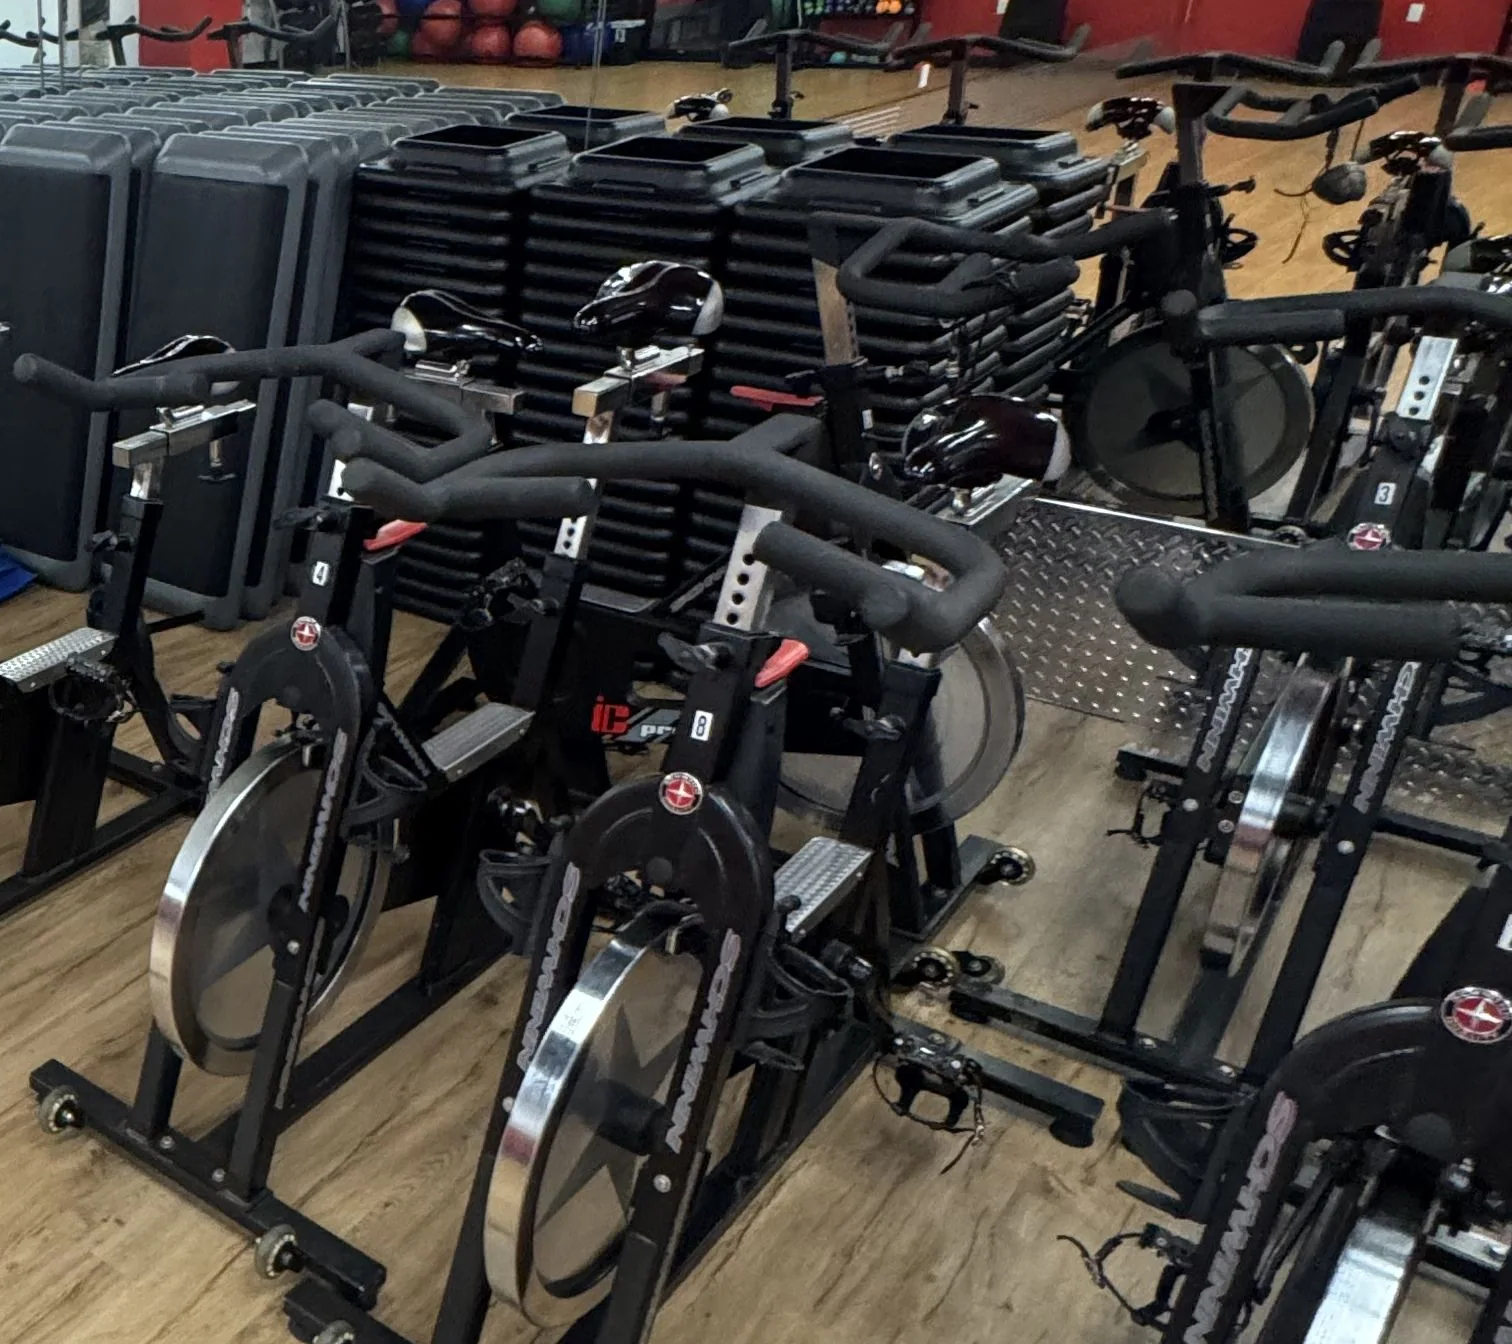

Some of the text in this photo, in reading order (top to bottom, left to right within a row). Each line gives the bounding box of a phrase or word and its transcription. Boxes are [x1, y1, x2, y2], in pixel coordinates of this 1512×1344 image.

[1378, 485, 1390, 503] 3
[696, 715, 707, 737] 8
[1196, 648, 1253, 773] HWINN
[1353, 661, 1421, 814] CHWINN
